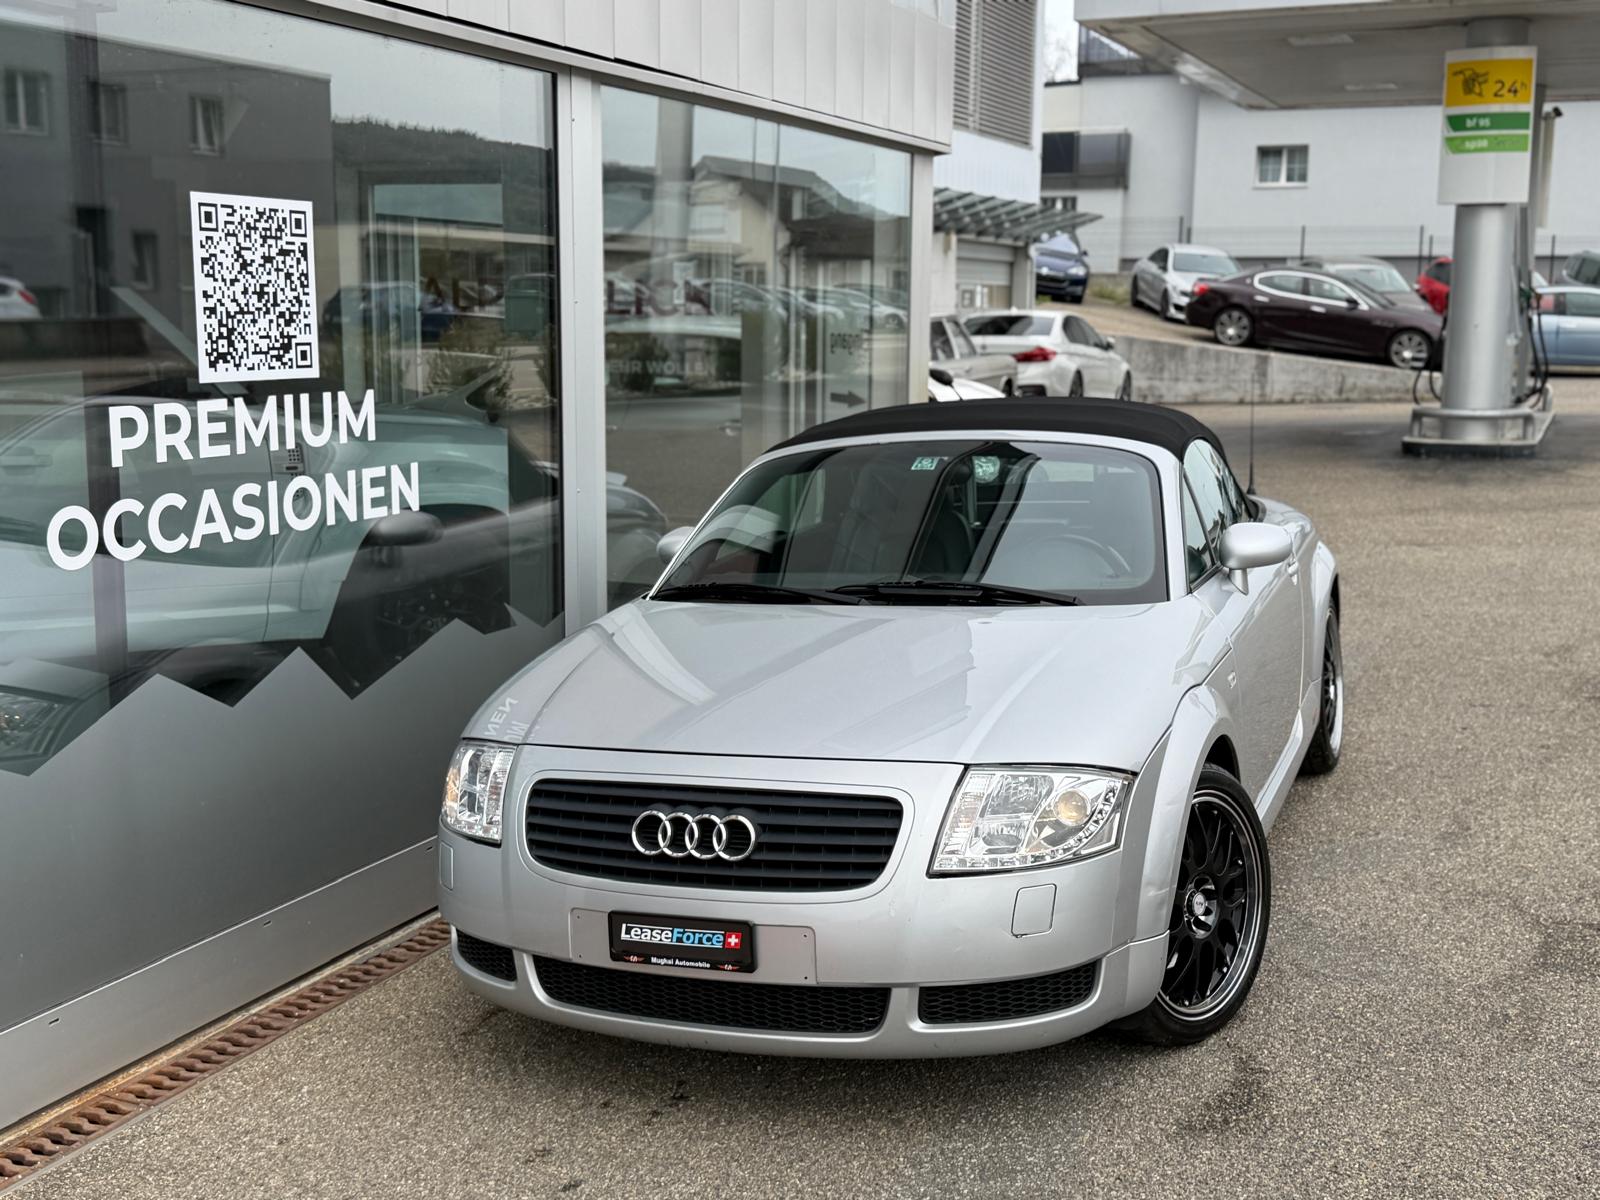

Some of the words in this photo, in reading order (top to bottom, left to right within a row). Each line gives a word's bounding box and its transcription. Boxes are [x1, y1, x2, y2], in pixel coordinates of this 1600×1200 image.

[108, 389, 377, 468] PREMIUM
[46, 462, 420, 572] OCCASIONEN
[620, 923, 724, 946] LeaseForce
[675, 958, 711, 969] Automobile
